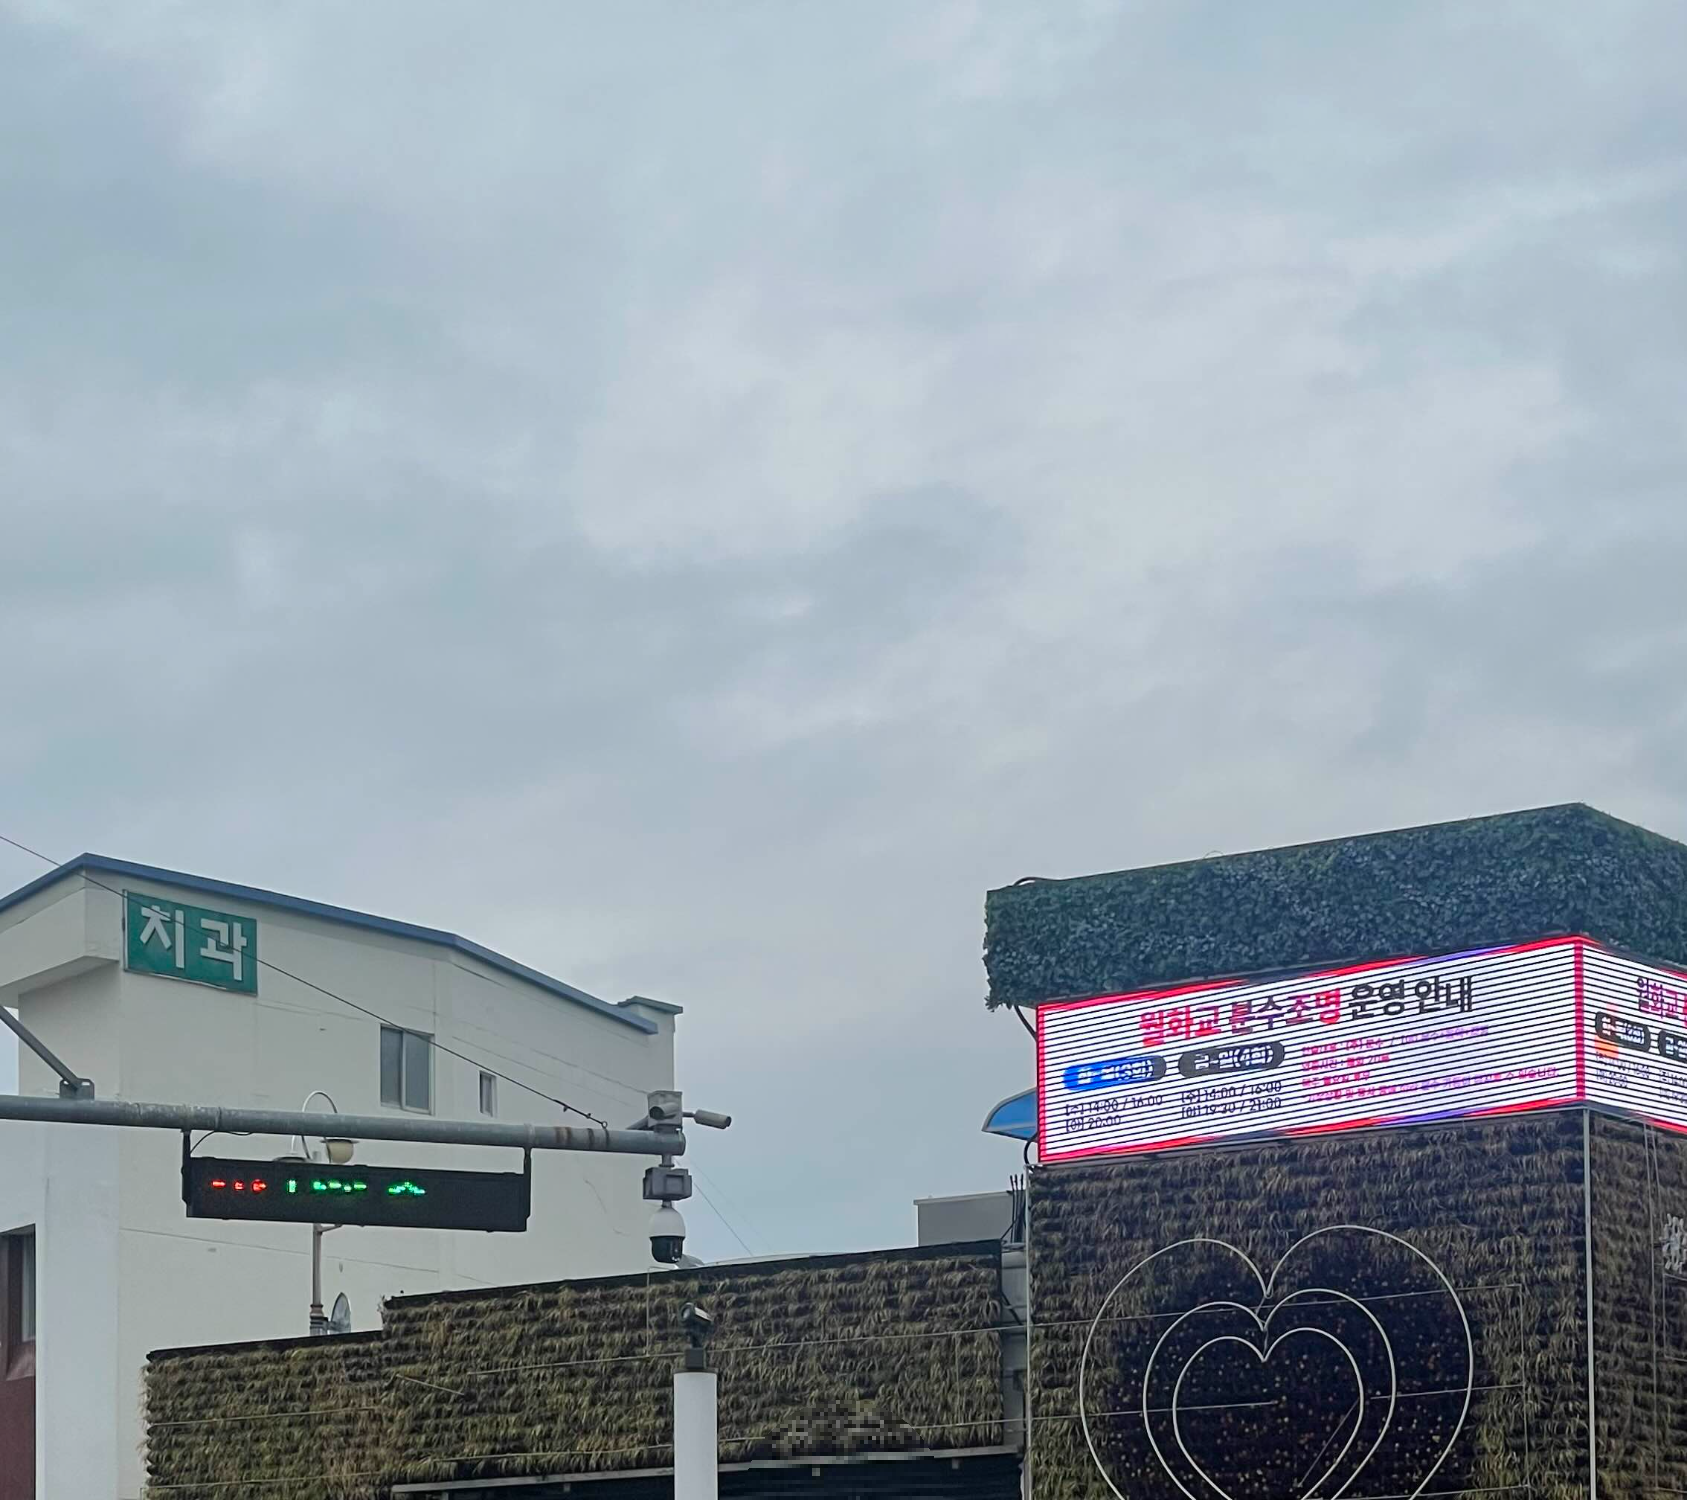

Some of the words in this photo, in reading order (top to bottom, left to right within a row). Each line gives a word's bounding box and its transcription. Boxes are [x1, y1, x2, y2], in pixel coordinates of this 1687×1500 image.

[140, 905, 247, 981] 치과
[1139, 1005, 1222, 1047] 월화교
[1230, 988, 1341, 1034] 분수조명
[1349, 979, 1405, 1020] 운영
[1415, 974, 1472, 1013] 안내
